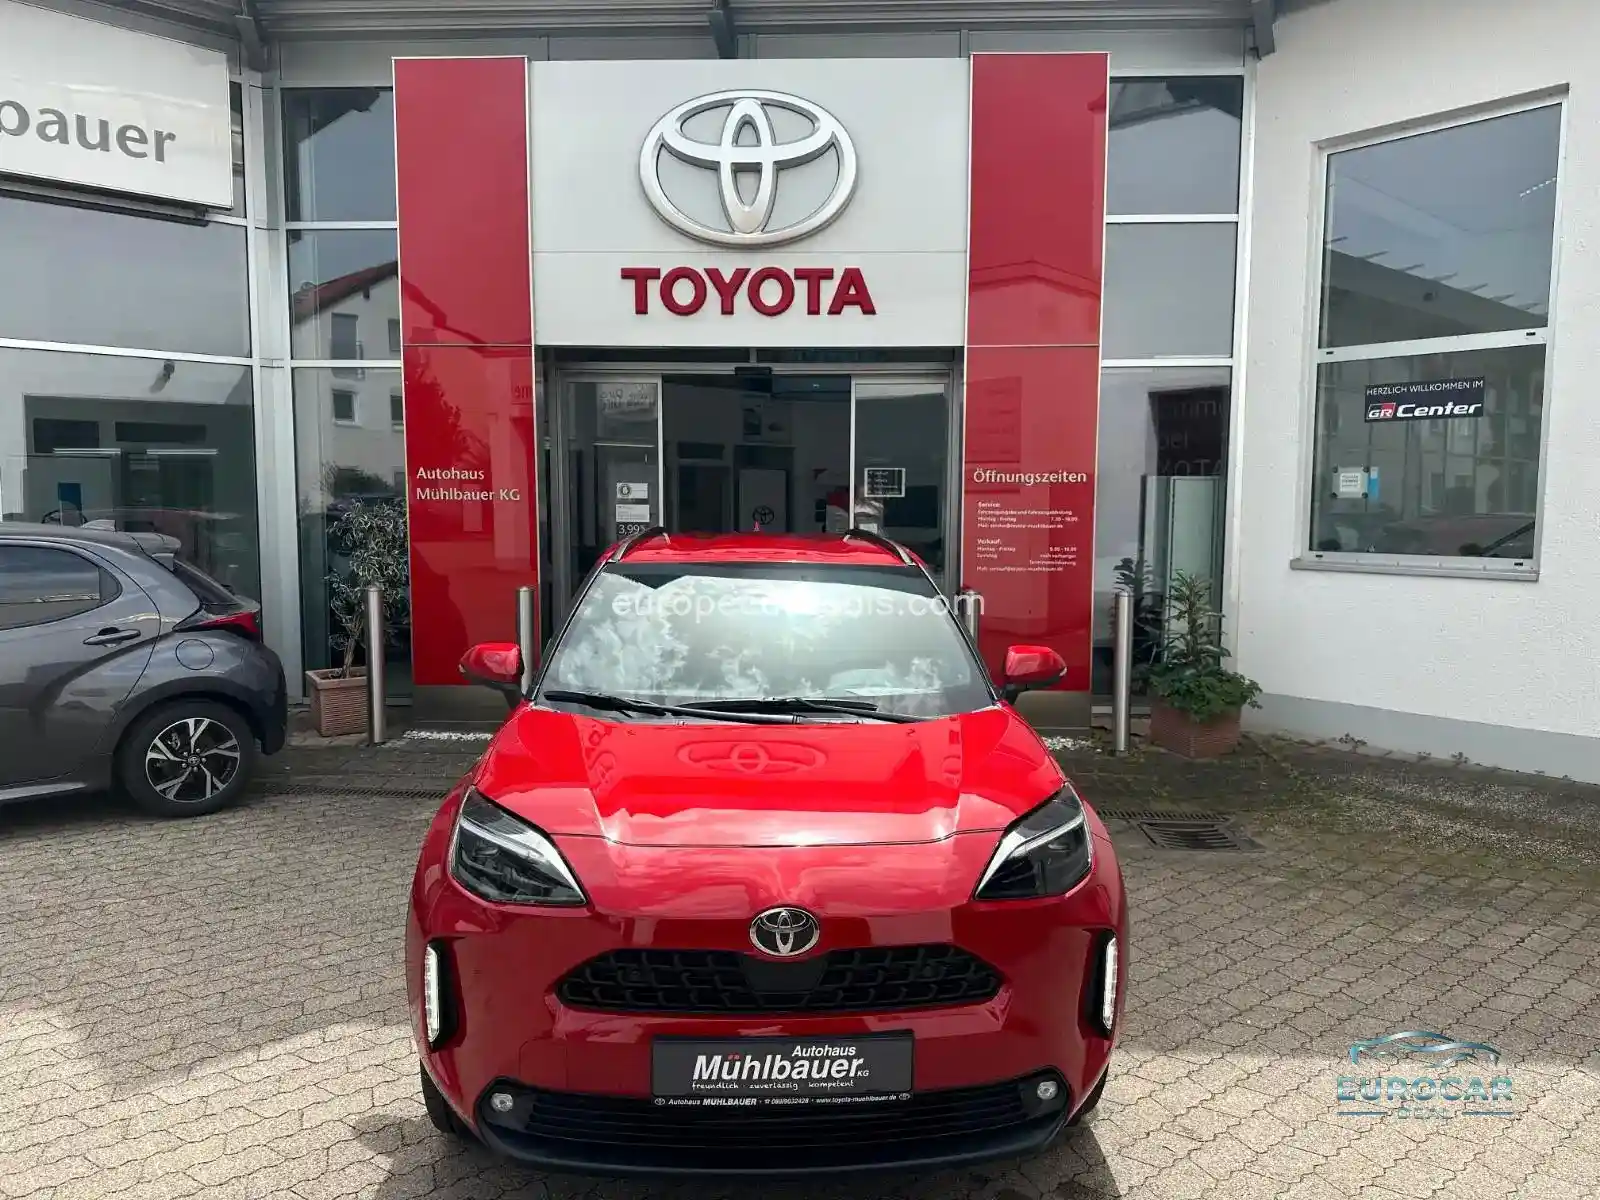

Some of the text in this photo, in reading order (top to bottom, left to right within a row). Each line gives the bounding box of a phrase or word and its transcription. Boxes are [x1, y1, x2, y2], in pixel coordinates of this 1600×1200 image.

[620, 267, 877, 316] TOYOTA
[1366, 380, 1484, 396] HERZLICH WILLKOMMEN IM
[1368, 401, 1482, 419] GR Center
[416, 467, 485, 479] Autohaus
[973, 468, 1087, 486] Öffnungszeiten
[416, 487, 520, 501] Mühlbauer KG
[791, 1044, 858, 1057] Autohaus
[692, 1052, 865, 1081] Mühlbauer
[691, 1080, 854, 1091] freundlich zuverlässig kompetent
